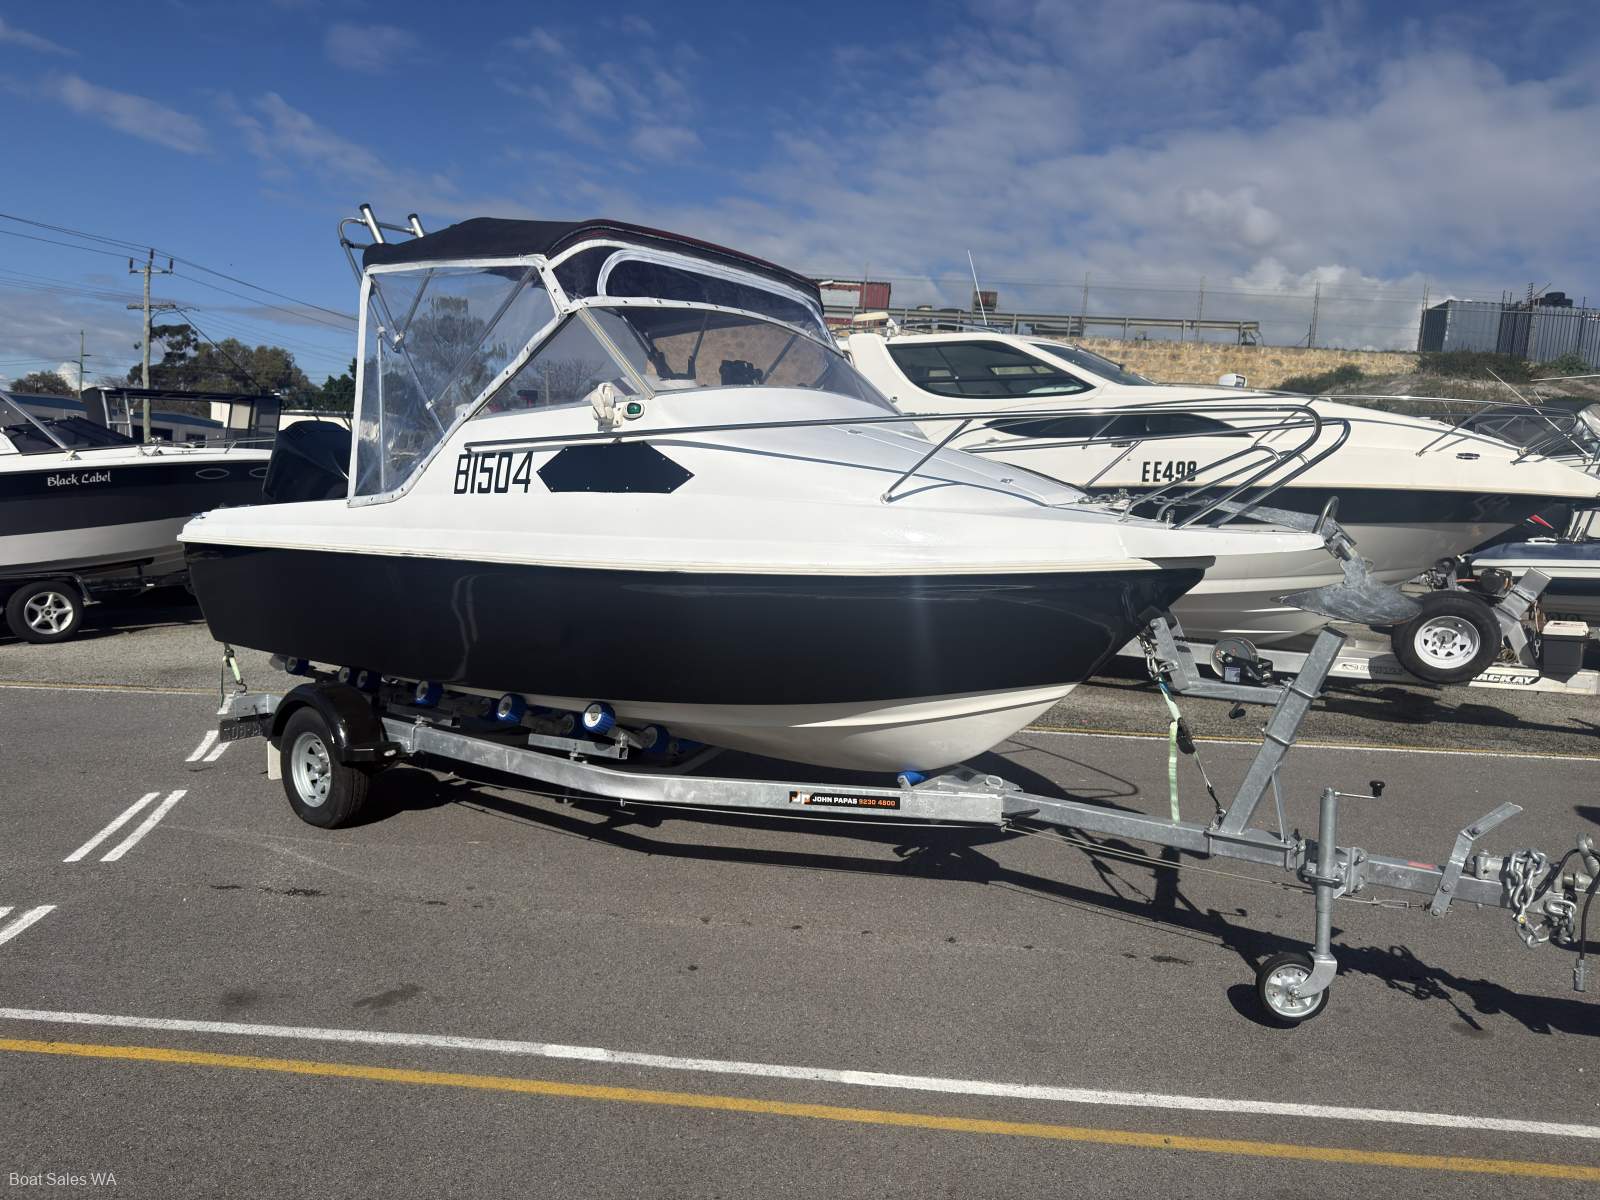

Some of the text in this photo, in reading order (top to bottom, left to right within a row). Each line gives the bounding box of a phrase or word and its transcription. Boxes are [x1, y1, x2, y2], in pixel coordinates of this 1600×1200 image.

[47, 469, 112, 487] Black Label
[1141, 460, 1197, 482] EE498
[1472, 673, 1536, 685] ACKAY
[833, 797, 858, 805] PAPAS
[858, 798, 877, 806] 9230
